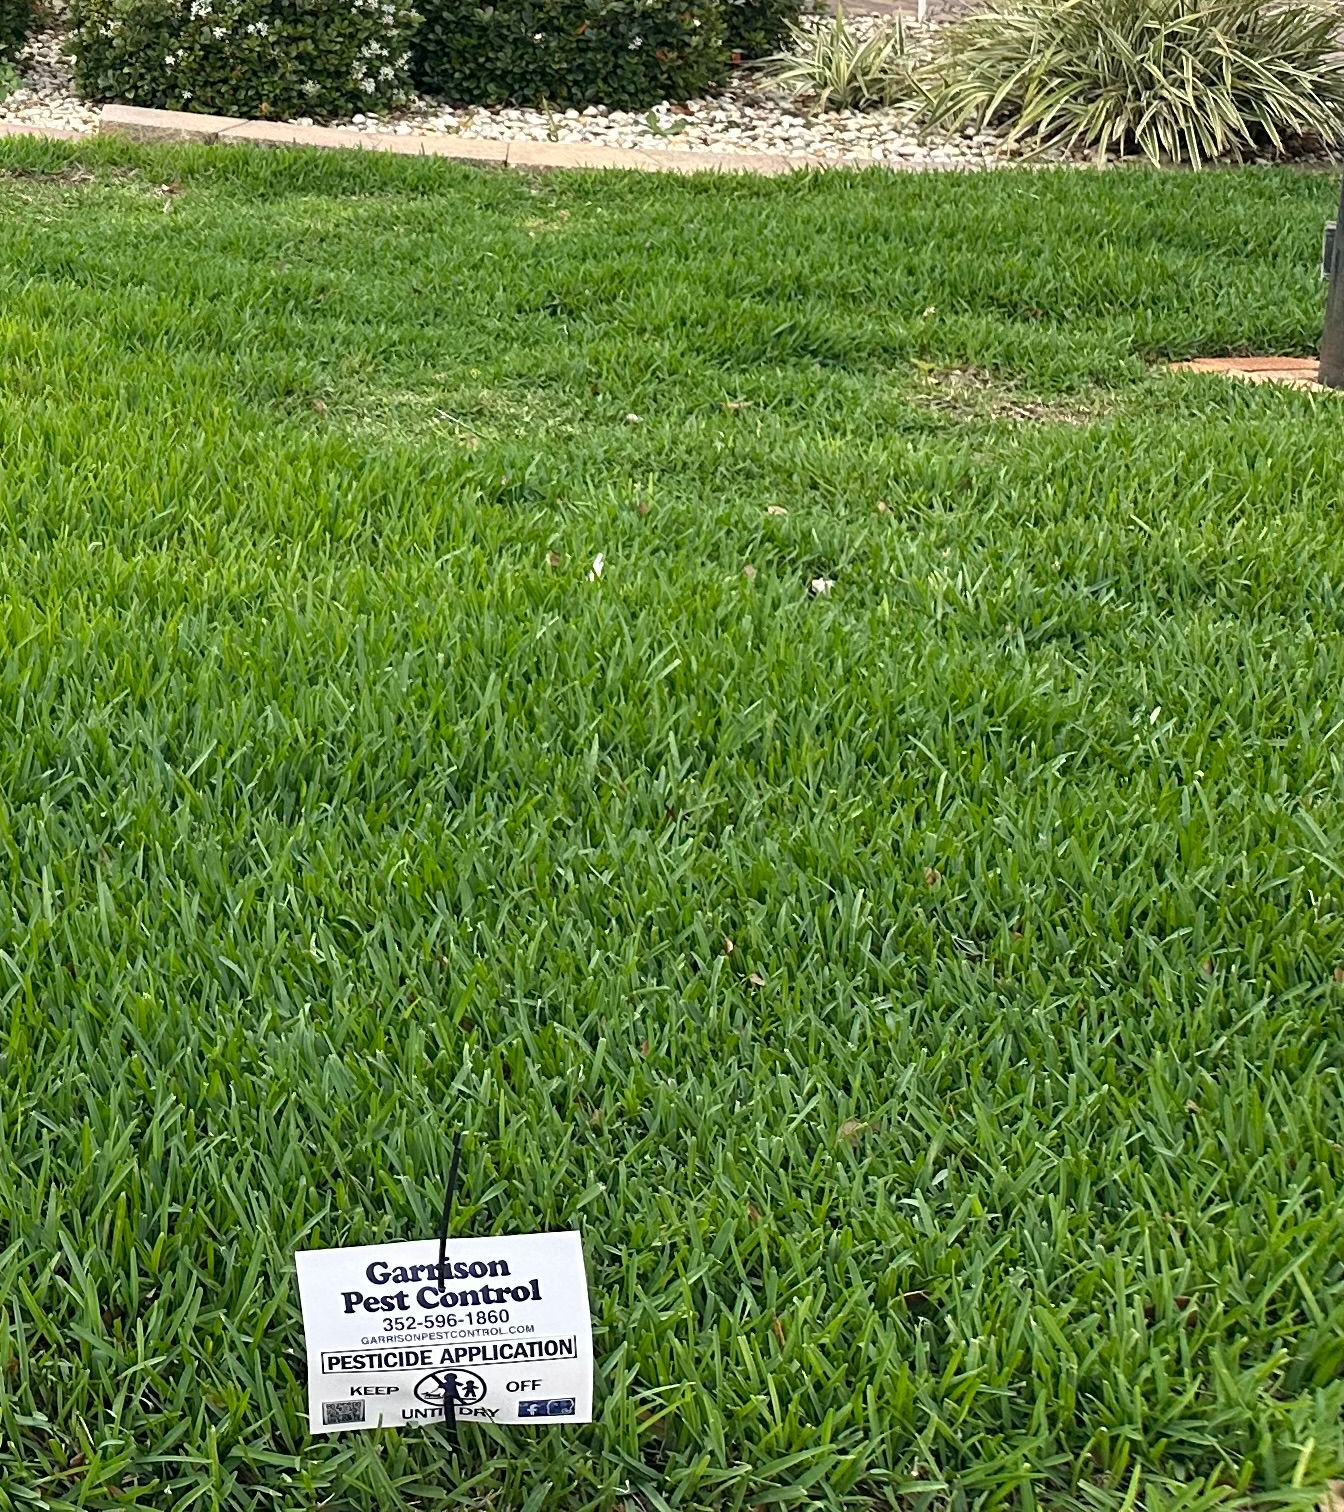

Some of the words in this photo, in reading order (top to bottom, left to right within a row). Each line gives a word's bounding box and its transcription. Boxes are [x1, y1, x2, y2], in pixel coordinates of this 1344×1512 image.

[366, 1257, 511, 1285] Garrison
[341, 1290, 409, 1314] Pest
[416, 1279, 543, 1310] Control
[382, 1309, 510, 1332] 352-596-1860
[360, 1325, 535, 1346] GARRISONPESTCONTROL.COM
[327, 1351, 433, 1371] PESTICIDE
[440, 1338, 573, 1365] APPLICATION
[350, 1385, 400, 1397] KEEP
[506, 1379, 543, 1393] OFF
[402, 1408, 445, 1420] UNTI
[459, 1406, 500, 1418] DRY
